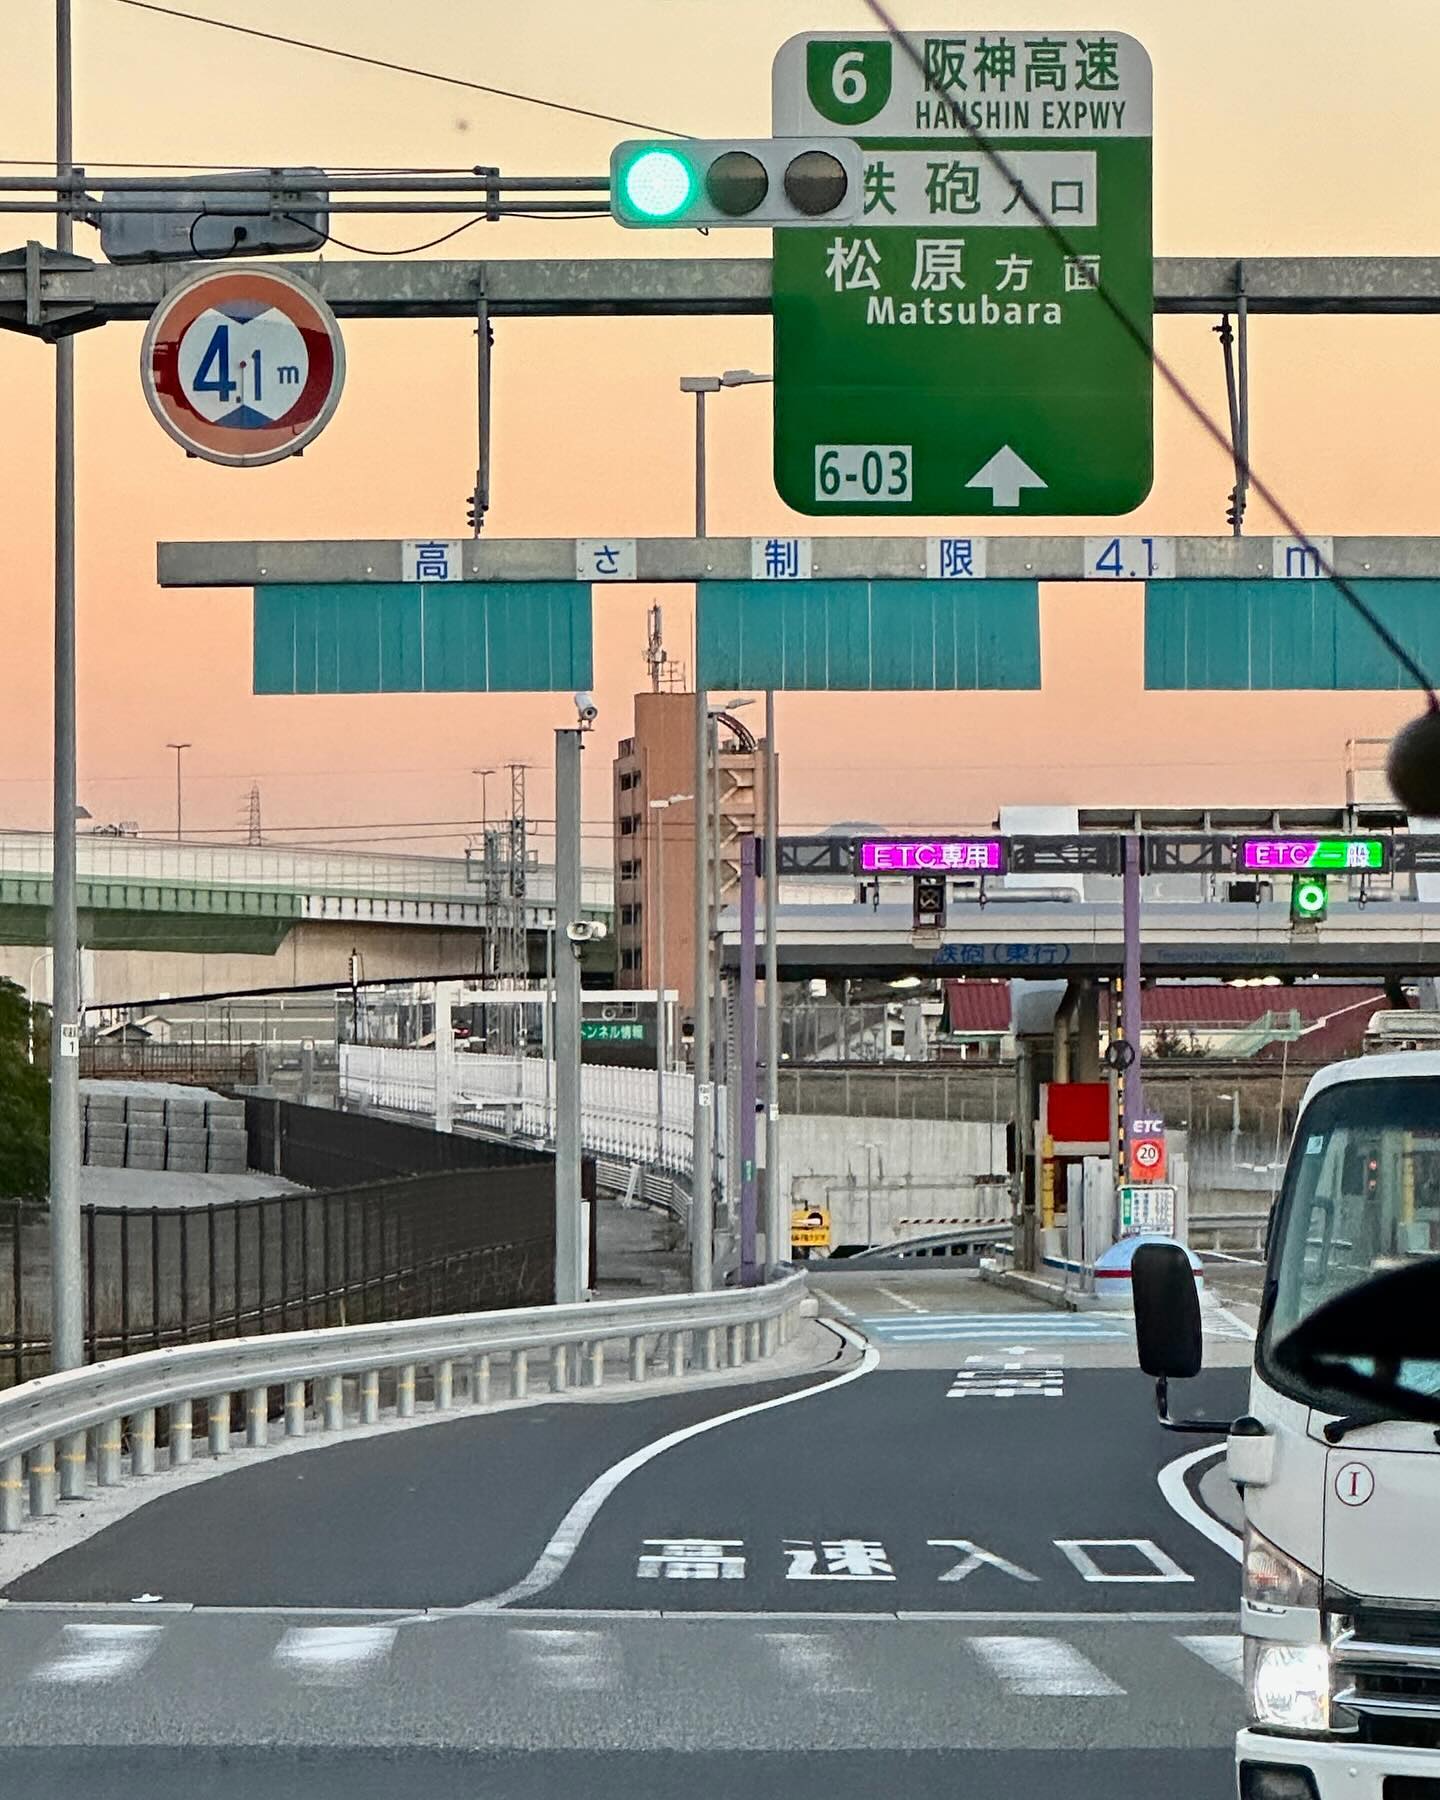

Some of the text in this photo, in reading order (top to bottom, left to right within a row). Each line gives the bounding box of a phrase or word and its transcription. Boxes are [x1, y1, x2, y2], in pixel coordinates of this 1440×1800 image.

[831, 51, 867, 104] 6
[923, 36, 1121, 92] 阪神高速
[916, 101, 1126, 129] HANSHIN EXPWY
[825, 236, 1101, 293] 松原方面
[866, 295, 1062, 325] Matsubara
[819, 450, 908, 495] 6-03
[580, 1024, 643, 1040] ンネル情報
[1133, 1120, 1163, 1133] ETC
[1139, 1147, 1156, 1160] 20
[636, 1538, 1196, 1583] 高速入口
